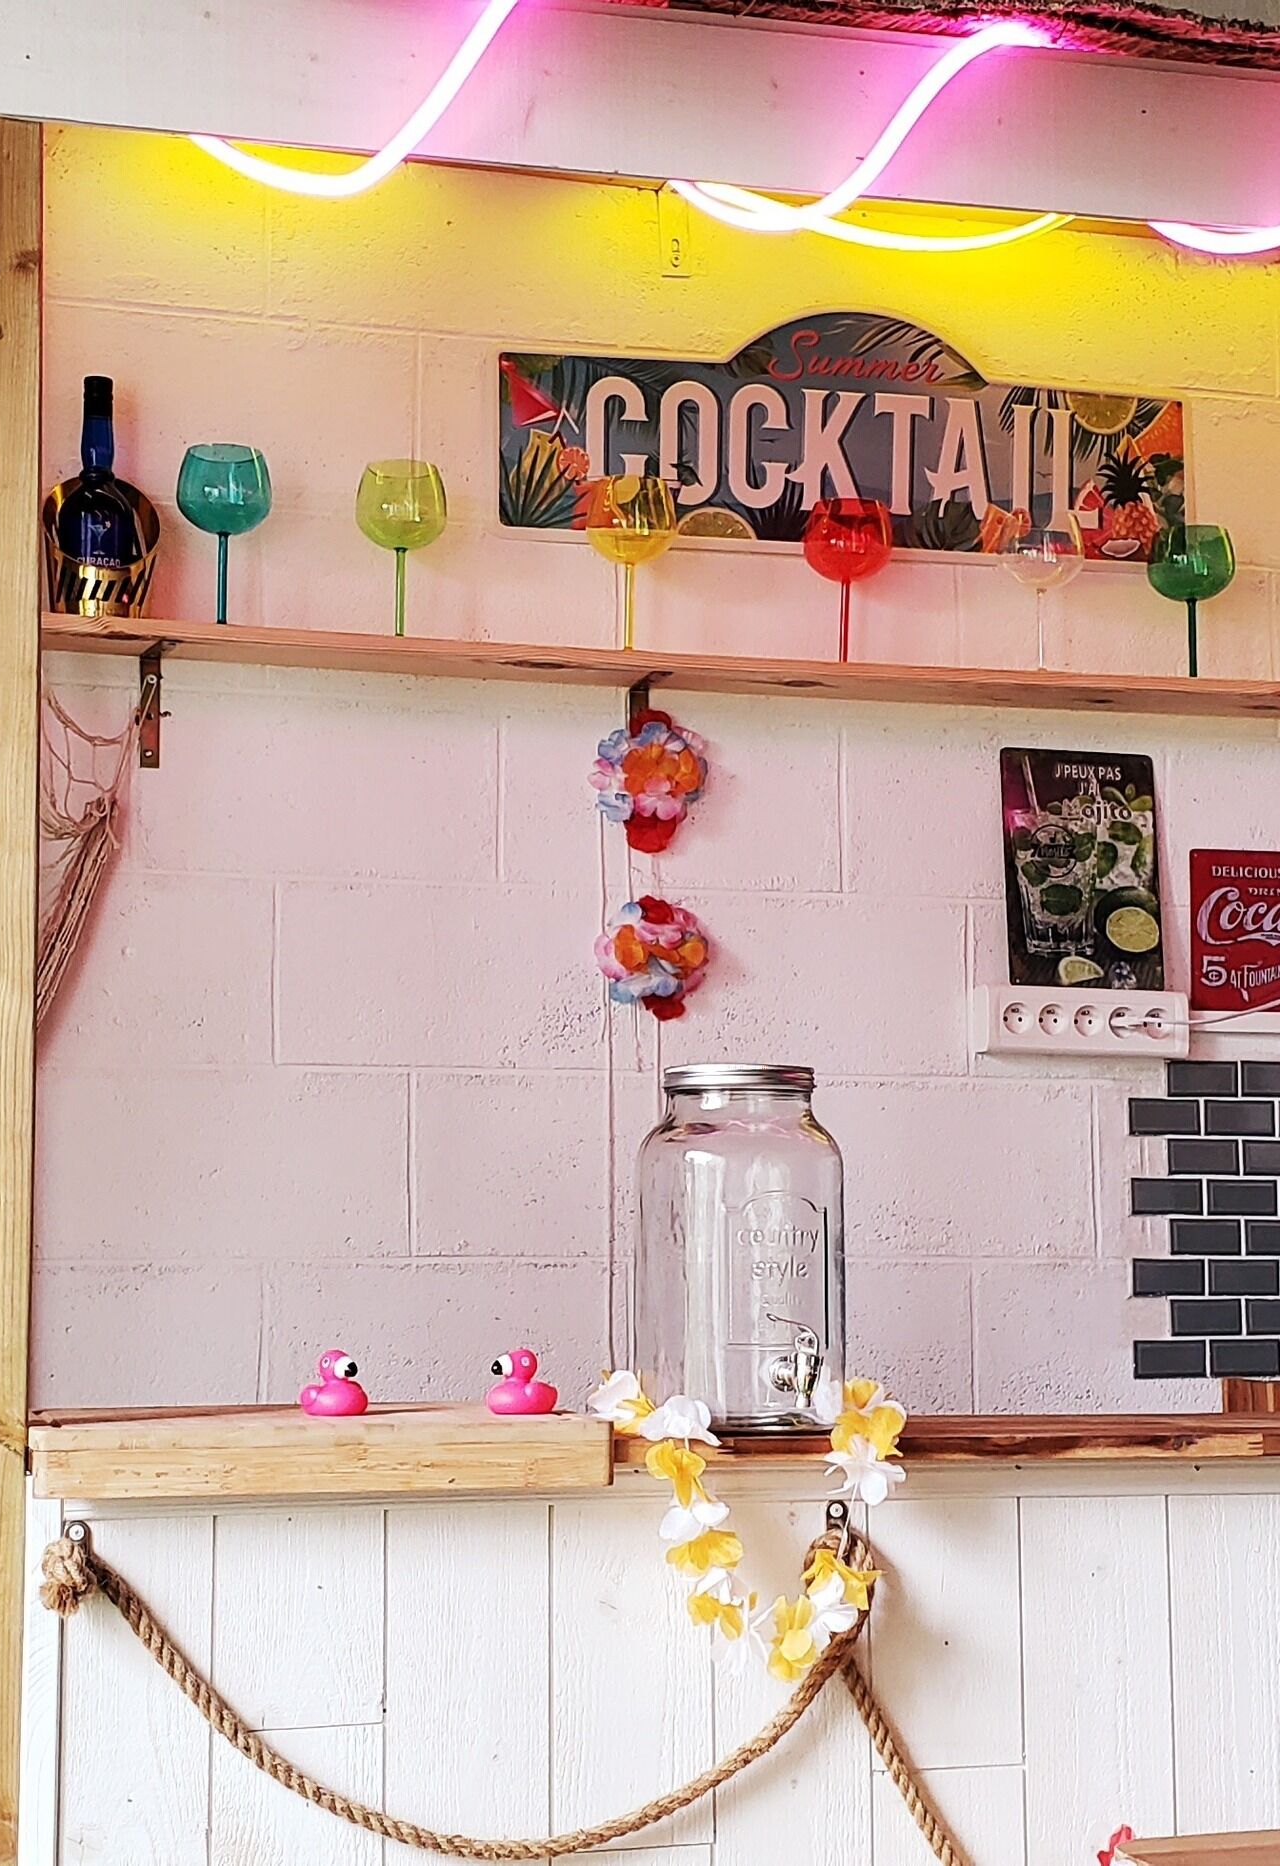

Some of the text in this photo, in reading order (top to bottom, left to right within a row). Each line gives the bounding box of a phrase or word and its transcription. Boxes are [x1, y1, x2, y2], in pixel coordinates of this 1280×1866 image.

[768, 330, 944, 384] Summer
[585, 376, 1099, 530] COCKTAIL
[1098, 766, 1122, 781] PAS
[1061, 798, 1132, 825] Mojito
[1230, 970, 1243, 989] AT
[751, 1255, 809, 1287] style
